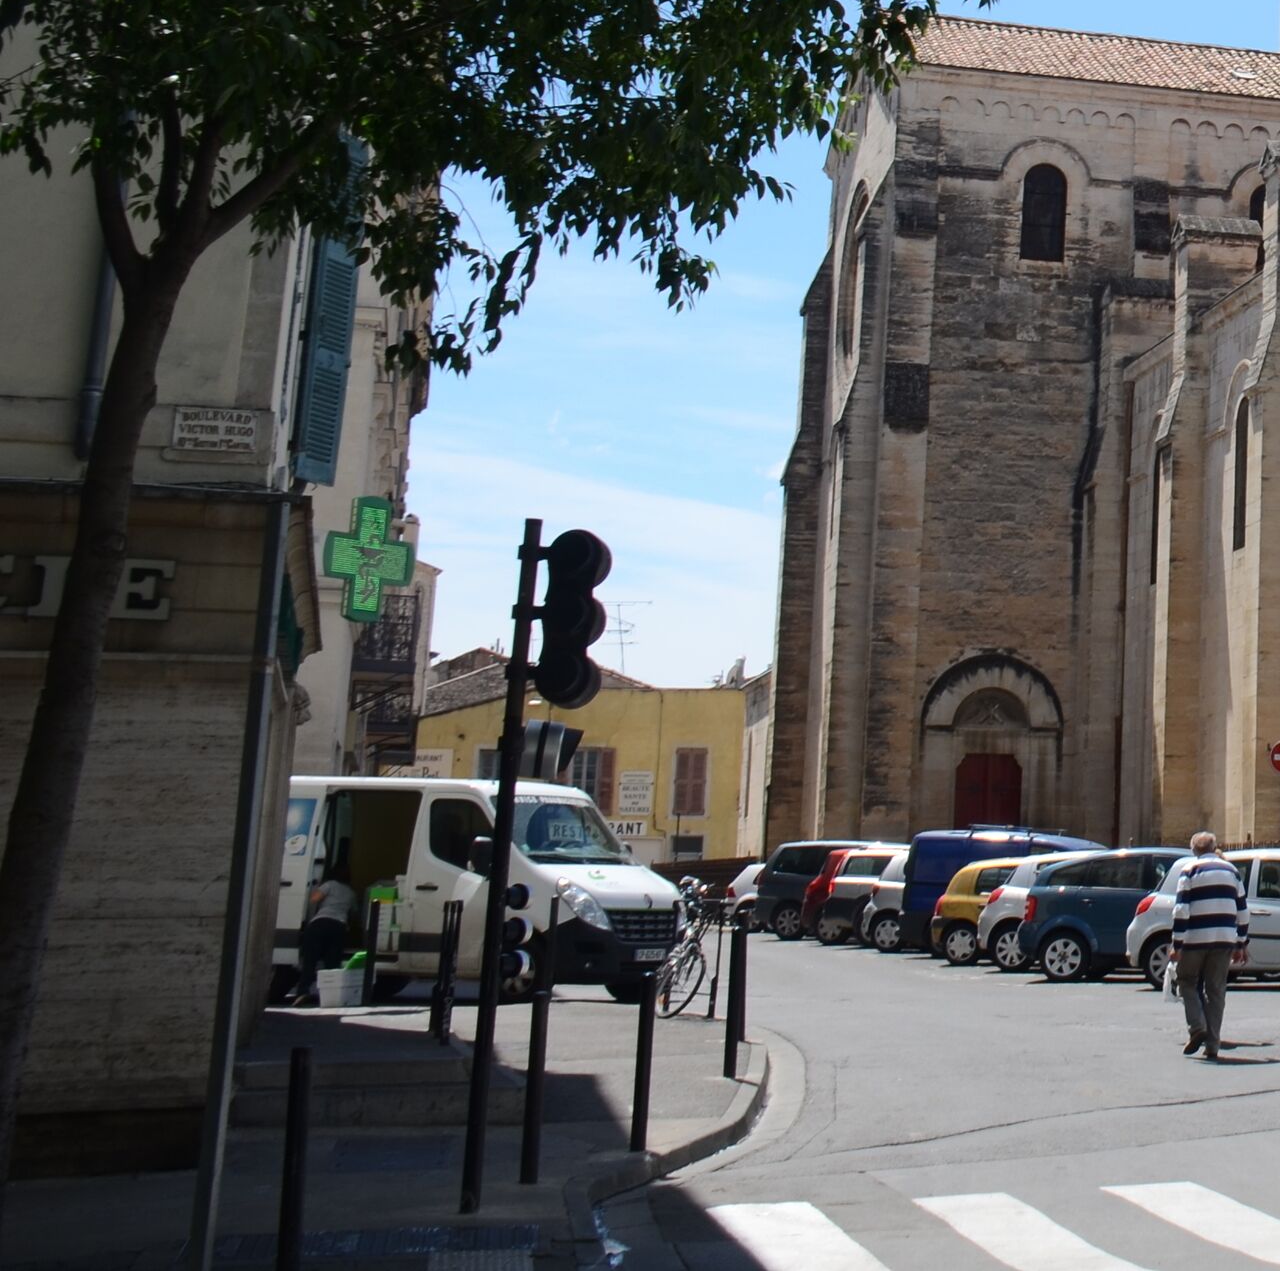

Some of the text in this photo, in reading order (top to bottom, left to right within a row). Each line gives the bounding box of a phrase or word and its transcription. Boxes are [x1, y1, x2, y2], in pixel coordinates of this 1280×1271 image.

[182, 411, 253, 425] BOULEVARD
[179, 424, 254, 437] VICTOR HUGO
[0, 555, 176, 621] IE
